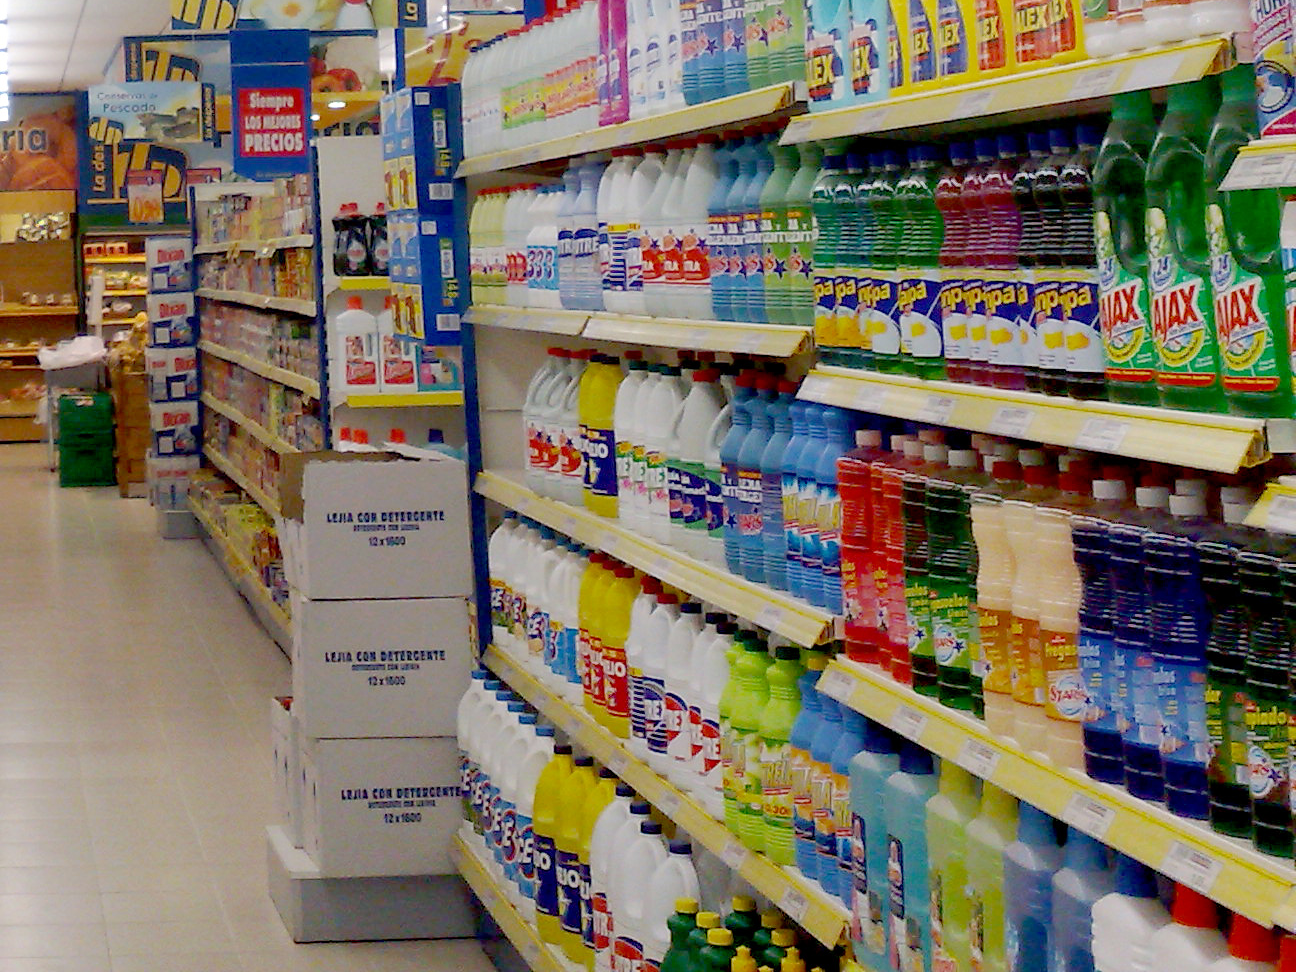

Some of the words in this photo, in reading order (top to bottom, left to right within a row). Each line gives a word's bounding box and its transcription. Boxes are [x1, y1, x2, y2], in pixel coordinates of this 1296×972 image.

[405, 2, 419, 22] La
[103, 103, 157, 113] Pescado
[249, 92, 295, 112] Siempre
[244, 115, 261, 130] LOS
[263, 114, 302, 130] MEJORES
[244, 134, 303, 153] PRECIOS
[327, 512, 354, 523] LEJIA
[357, 512, 377, 523] CON
[381, 510, 445, 523] DETERGENTE
[325, 651, 353, 663] LEJIA
[356, 651, 377, 662] CON
[381, 650, 446, 662] DETERGENTE
[341, 789, 369, 800] LEJIA
[372, 788, 393, 800] CON
[397, 786, 461, 799] DETERGENTE
